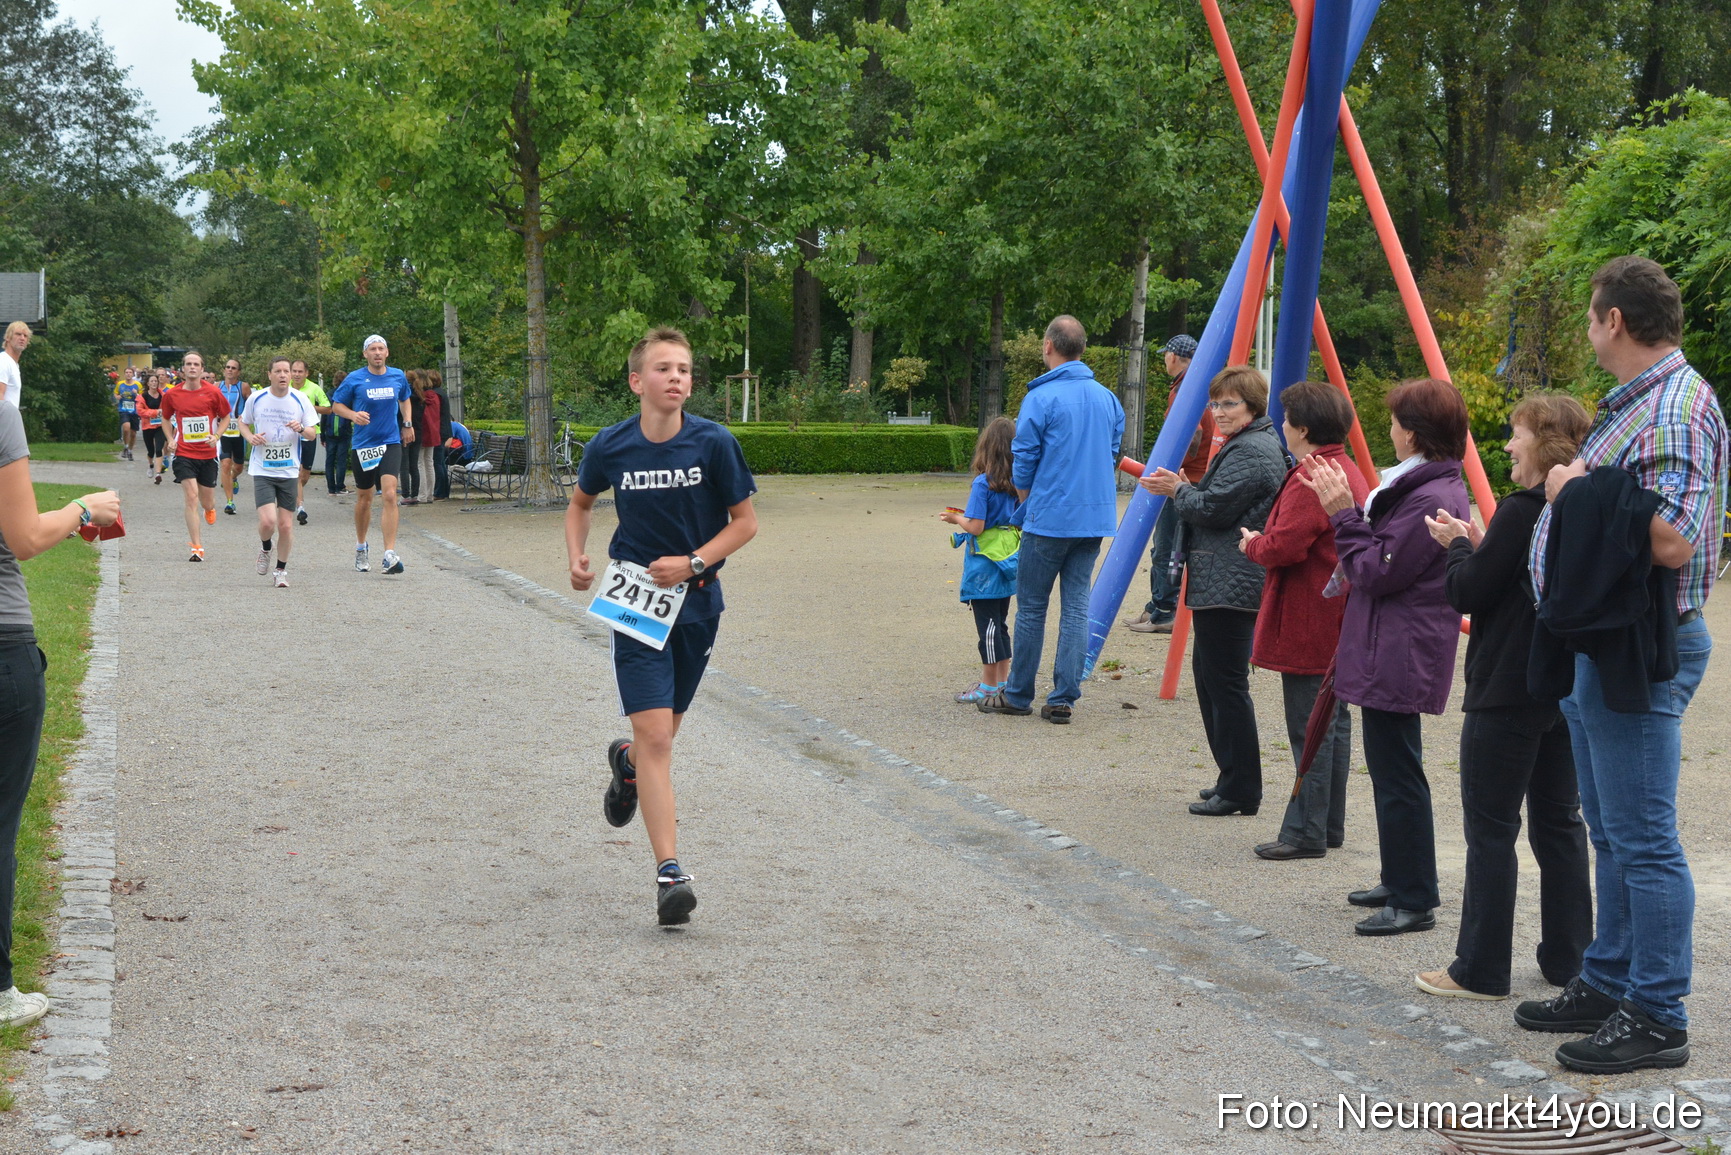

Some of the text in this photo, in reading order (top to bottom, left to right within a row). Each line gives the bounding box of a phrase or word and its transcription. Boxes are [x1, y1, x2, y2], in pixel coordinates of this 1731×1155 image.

[366, 387, 394, 395] HUBER
[188, 422, 205, 433] 109
[265, 447, 291, 460] 2345
[361, 446, 384, 461] 2856
[620, 466, 702, 490] ADIDAS
[605, 572, 675, 619] 2415
[618, 611, 638, 626] Jan
